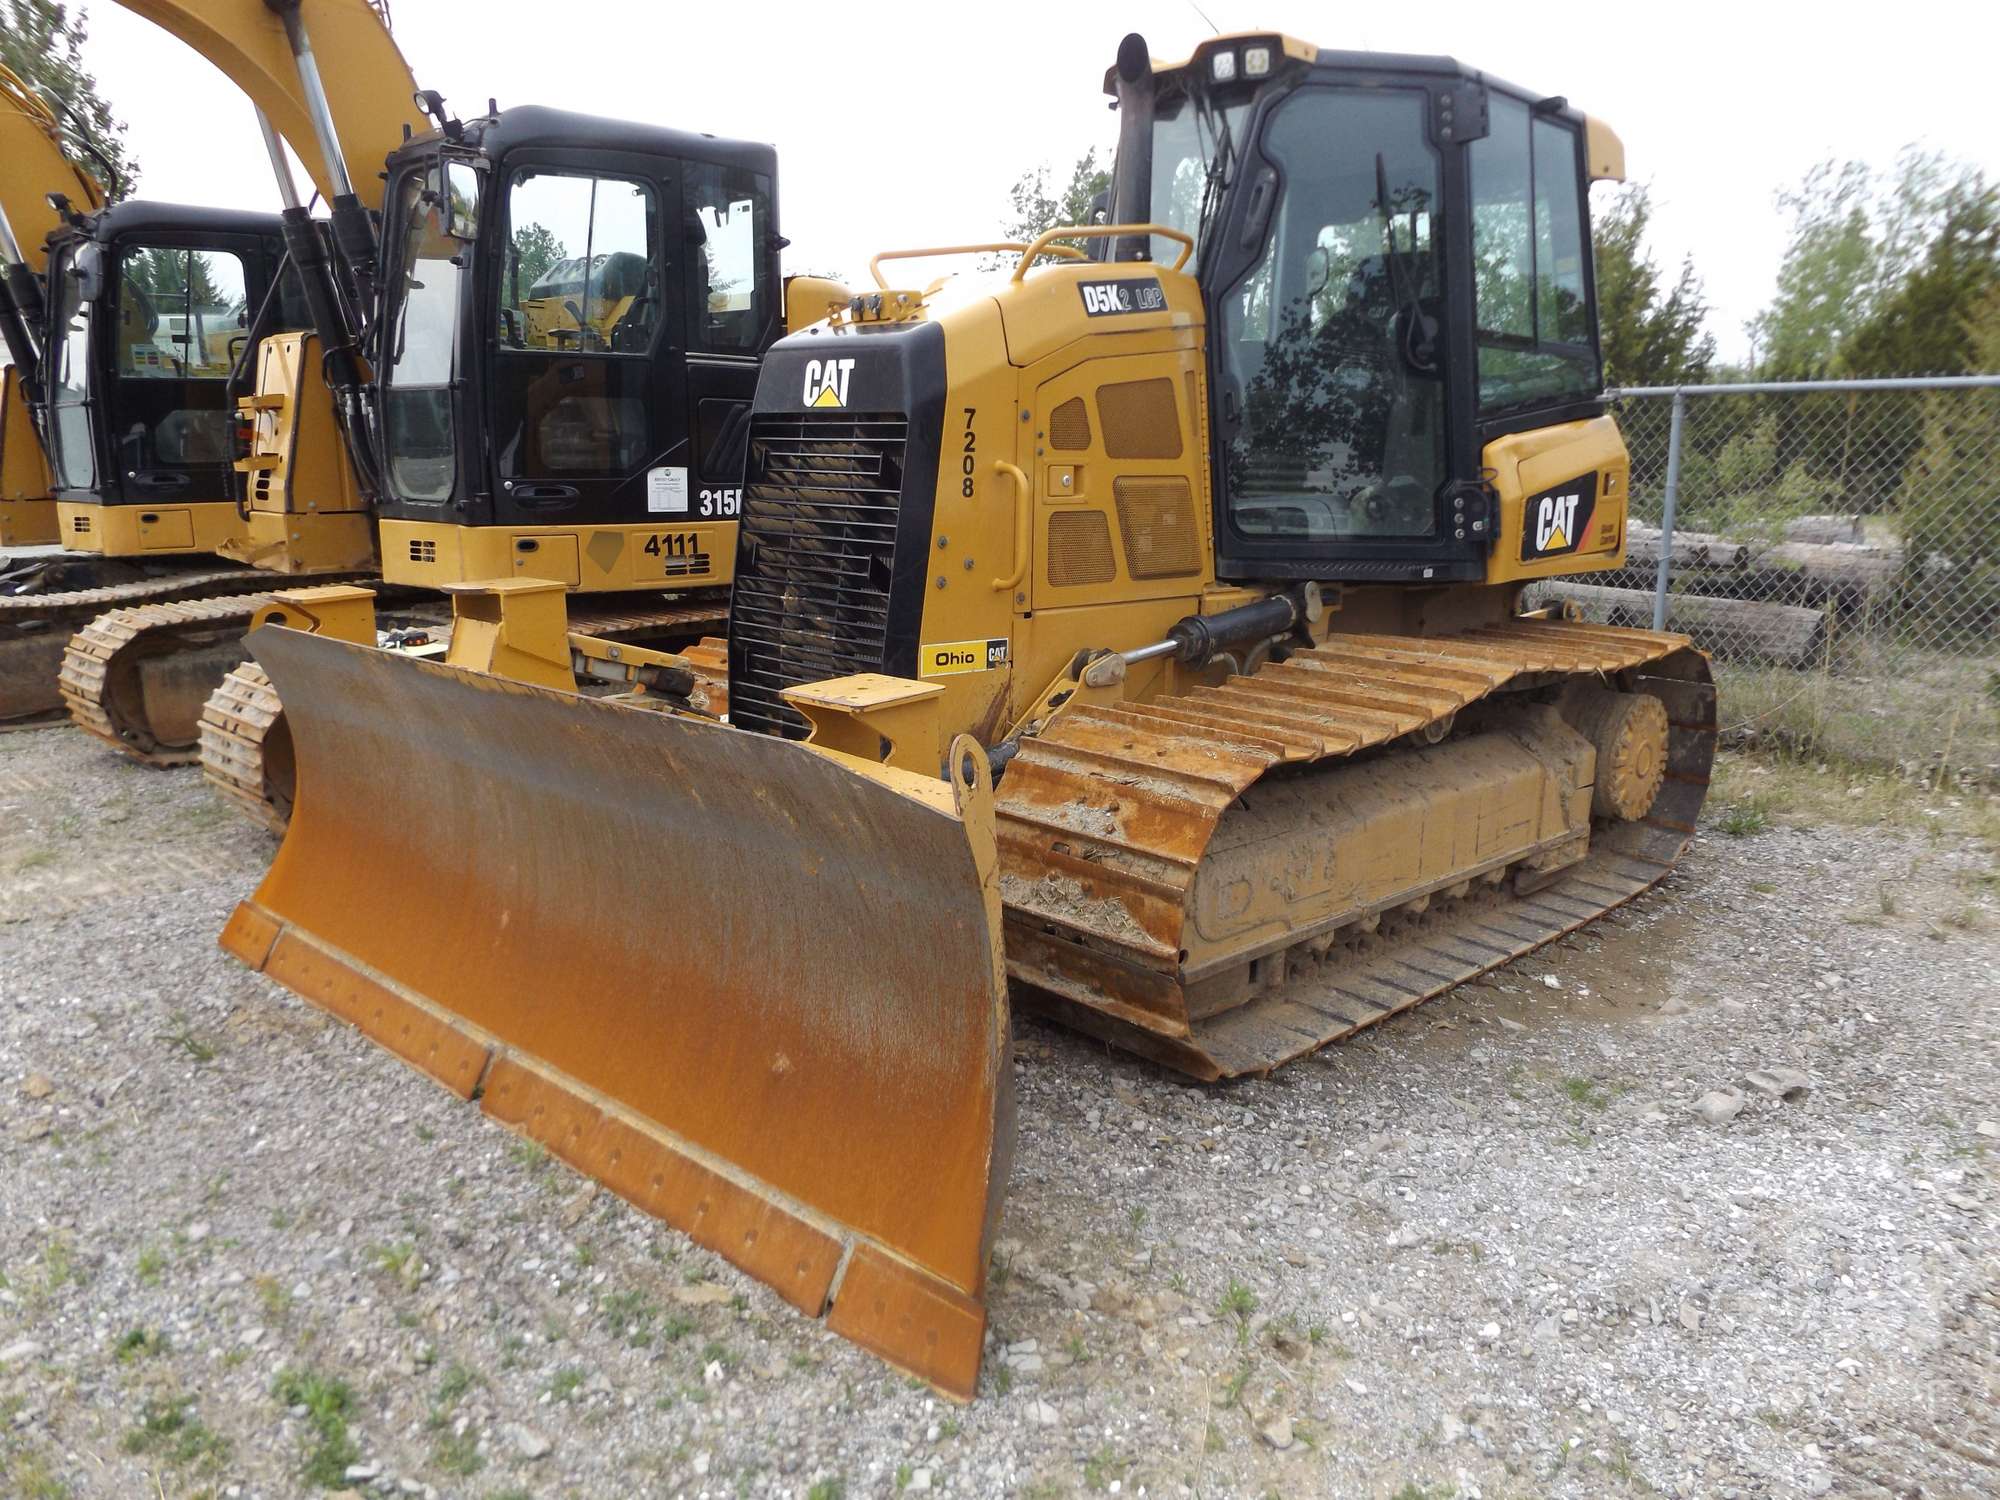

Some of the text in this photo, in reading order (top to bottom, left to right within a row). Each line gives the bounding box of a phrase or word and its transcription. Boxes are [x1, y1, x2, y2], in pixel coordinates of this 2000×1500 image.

[1083, 284, 1162, 313] D5K2 LGP
[803, 359, 855, 408] CAT
[962, 408, 977, 498] 7208
[1536, 494, 1579, 551] CAT
[644, 533, 698, 557] 4111
[936, 646, 1007, 666] Ohio CAT
